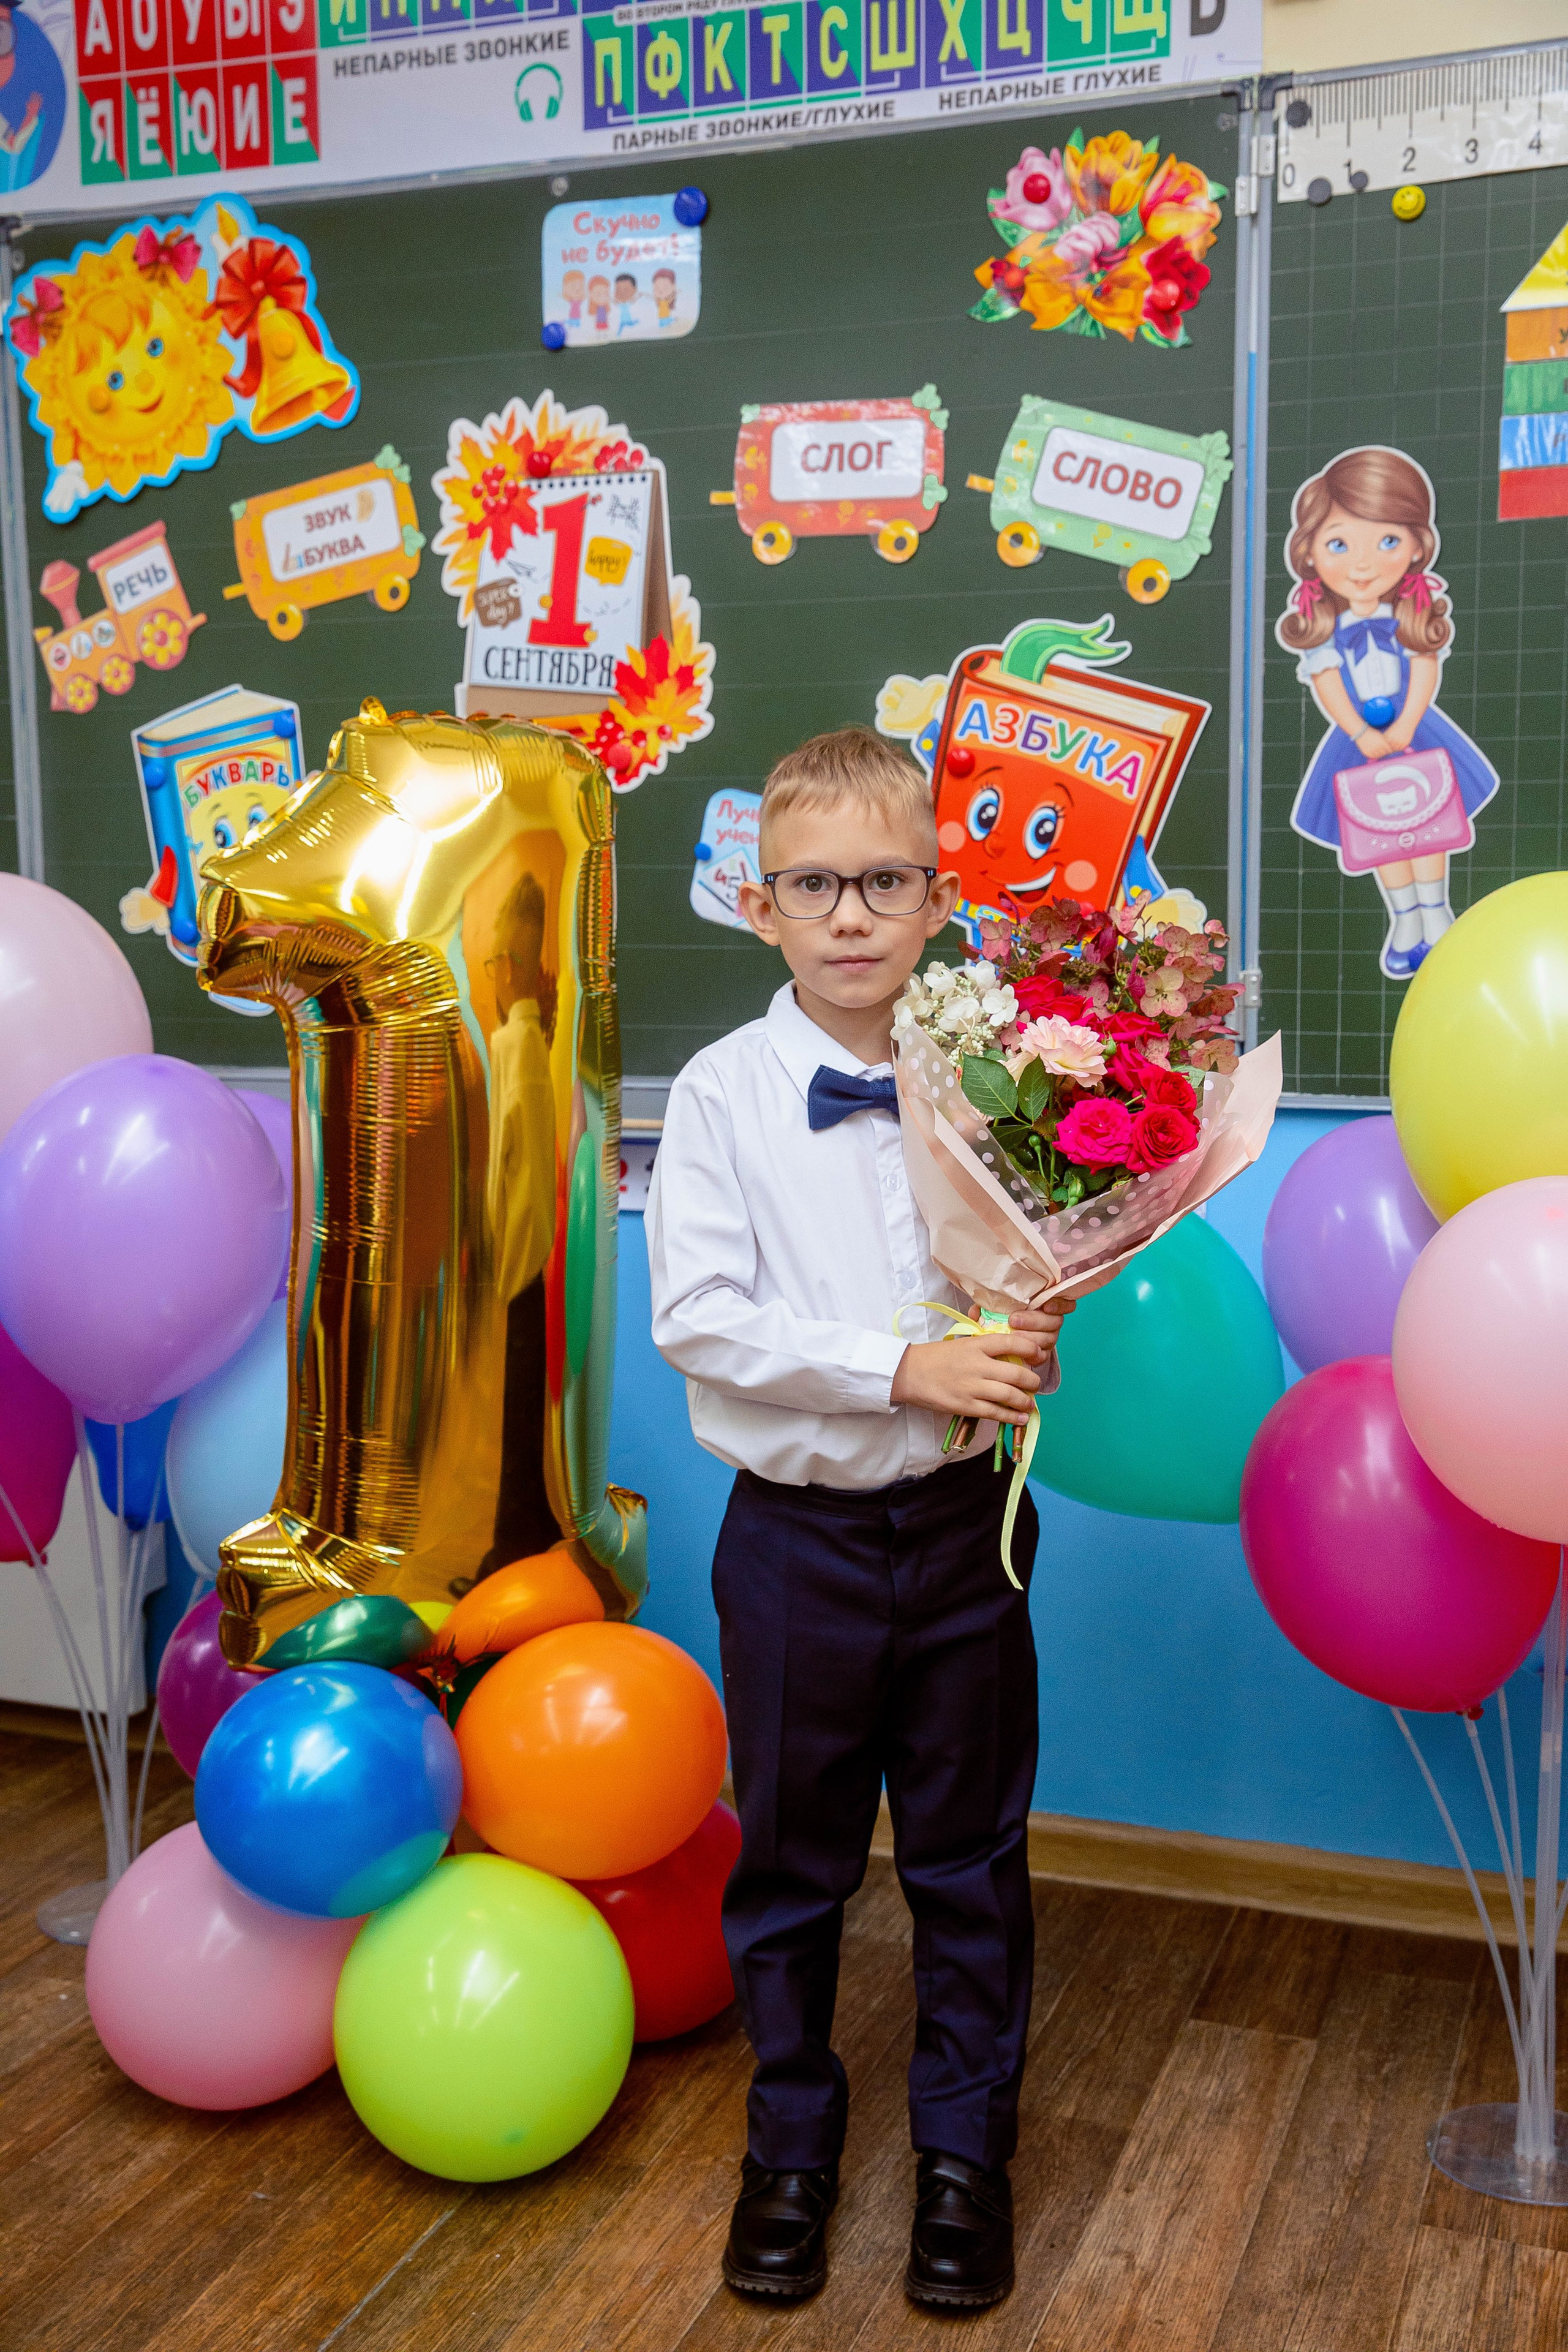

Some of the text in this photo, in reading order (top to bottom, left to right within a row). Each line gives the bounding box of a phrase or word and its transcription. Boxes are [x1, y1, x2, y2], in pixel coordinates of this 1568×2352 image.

[334, 29, 570, 78] НЕПАРНЫЕ ЗВОНКИЕ
[594, 37, 622, 107] П
[644, 31, 682, 99] Ф
[705, 22, 734, 94] К
[762, 14, 790, 85] Т
[820, 6, 848, 78] С
[870, 0, 916, 71] Ш
[938, 0, 968, 63] Х
[939, 64, 1162, 111] НЕПАРНЫЕ ГЛУХИЕ
[90, 78, 307, 165] Я Ё Ю И Е
[613, 100, 896, 151] ПАРНЫЕ ЗВОНКИЕ/ГЛУХИЕ
[1281, 162, 1296, 187] 0
[1402, 147, 1417, 172] 2
[1464, 138, 1480, 165] 3
[1528, 129, 1543, 155] 4
[561, 232, 680, 266] не будет!
[573, 211, 661, 239] Скучно
[800, 440, 893, 473] СЛОГ
[1052, 450, 1184, 510] СЛОВО
[304, 503, 352, 533] ЗВУК
[303, 533, 366, 566] БУКВА
[527, 492, 592, 648] 1
[113, 563, 168, 604] РЕЧЬ
[484, 645, 614, 688] СЕНТЯБРЯ
[957, 700, 1145, 799] АЗБУКА
[184, 758, 292, 809] БУКВАРЬ
